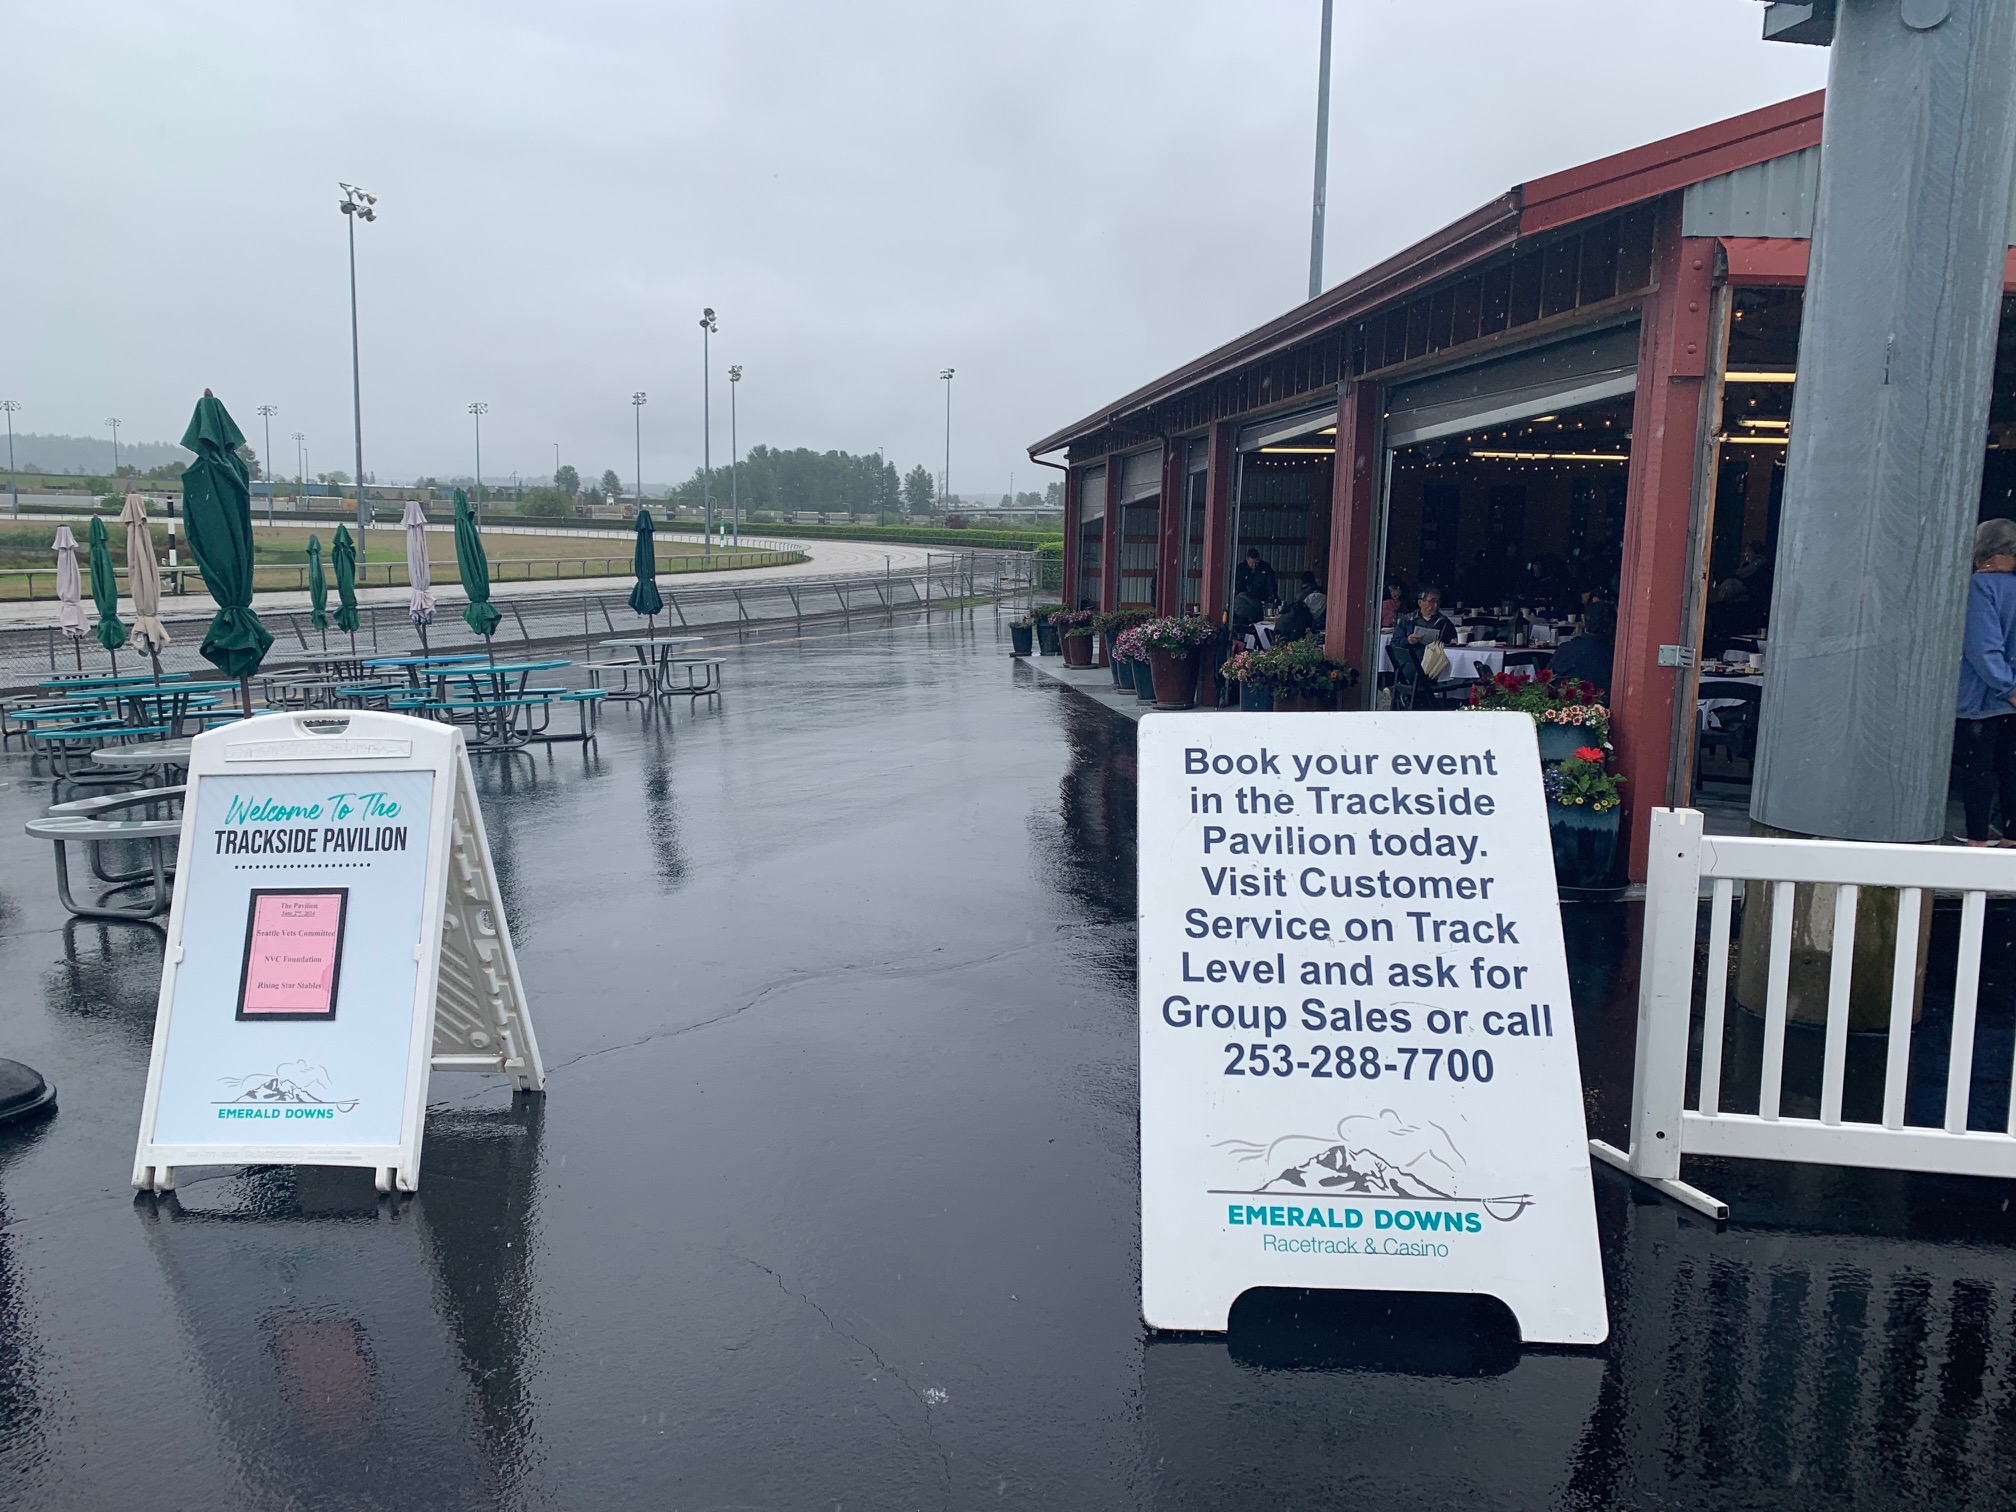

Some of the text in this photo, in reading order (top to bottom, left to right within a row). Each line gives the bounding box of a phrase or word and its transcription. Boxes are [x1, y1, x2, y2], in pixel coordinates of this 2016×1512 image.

[1185, 748, 1497, 782] Book your event
[225, 792, 401, 825] Welcome To The
[1191, 787, 1494, 815] in the Trackside
[215, 827, 407, 854] TRACKSIDE PAVILION
[1204, 826, 1487, 864] Pavilion today.
[1201, 867, 1494, 899] Visit Customer
[1185, 908, 1519, 944] Service on Track
[258, 982, 279, 990] Rising
[1183, 952, 1528, 989] Level and ask for
[1163, 995, 1553, 1037] Group Sales or call
[1224, 1043, 1493, 1082] 253-288-7700
[218, 1109, 333, 1119] EMERALD DOWNS
[1229, 1205, 1482, 1233] EMERALD DOWNS
[1263, 1234, 1449, 1258] Racetrack & Casino
